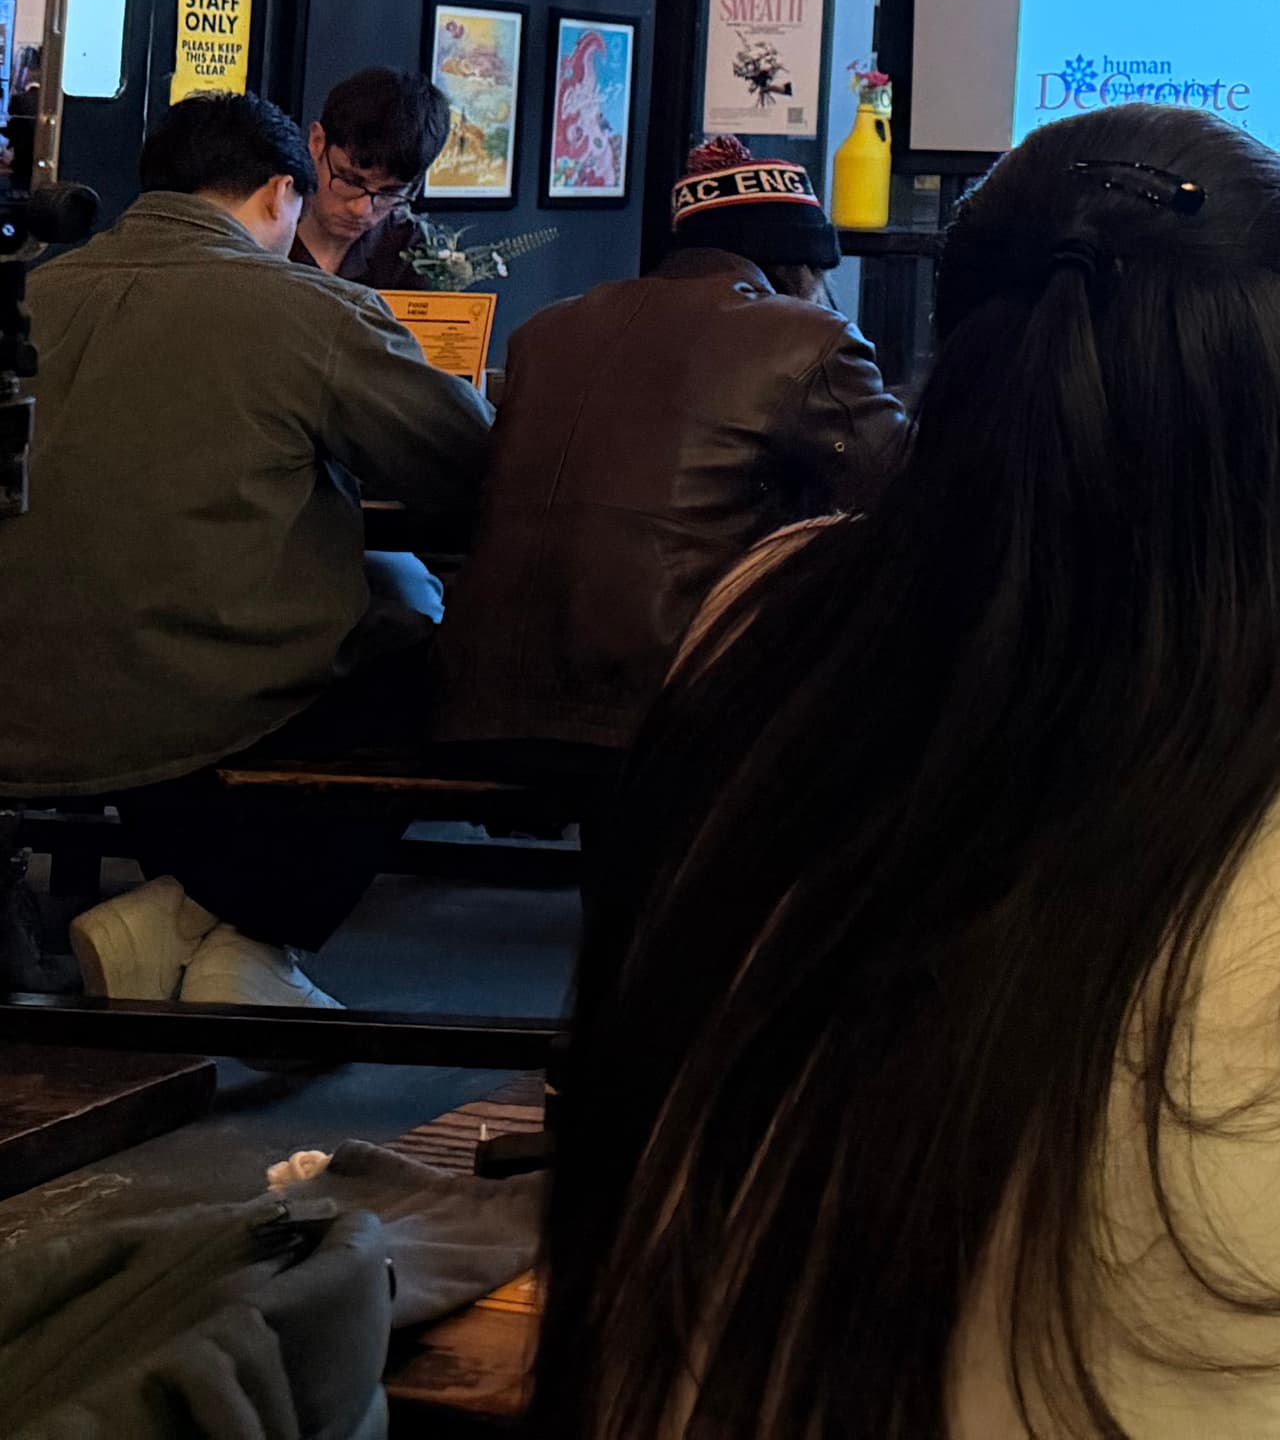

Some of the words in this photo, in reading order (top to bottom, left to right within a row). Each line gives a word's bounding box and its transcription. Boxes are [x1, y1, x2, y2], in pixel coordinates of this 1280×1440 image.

[184, 11, 239, 35] ONLY
[181, 39, 215, 53] PLEASE
[218, 42, 243, 54] KEEP
[185, 51, 207, 64] THIS
[209, 53, 237, 65] AREA
[1103, 54, 1172, 75] human
[194, 63, 226, 76] CLEAR
[735, 169, 804, 195] ENG
